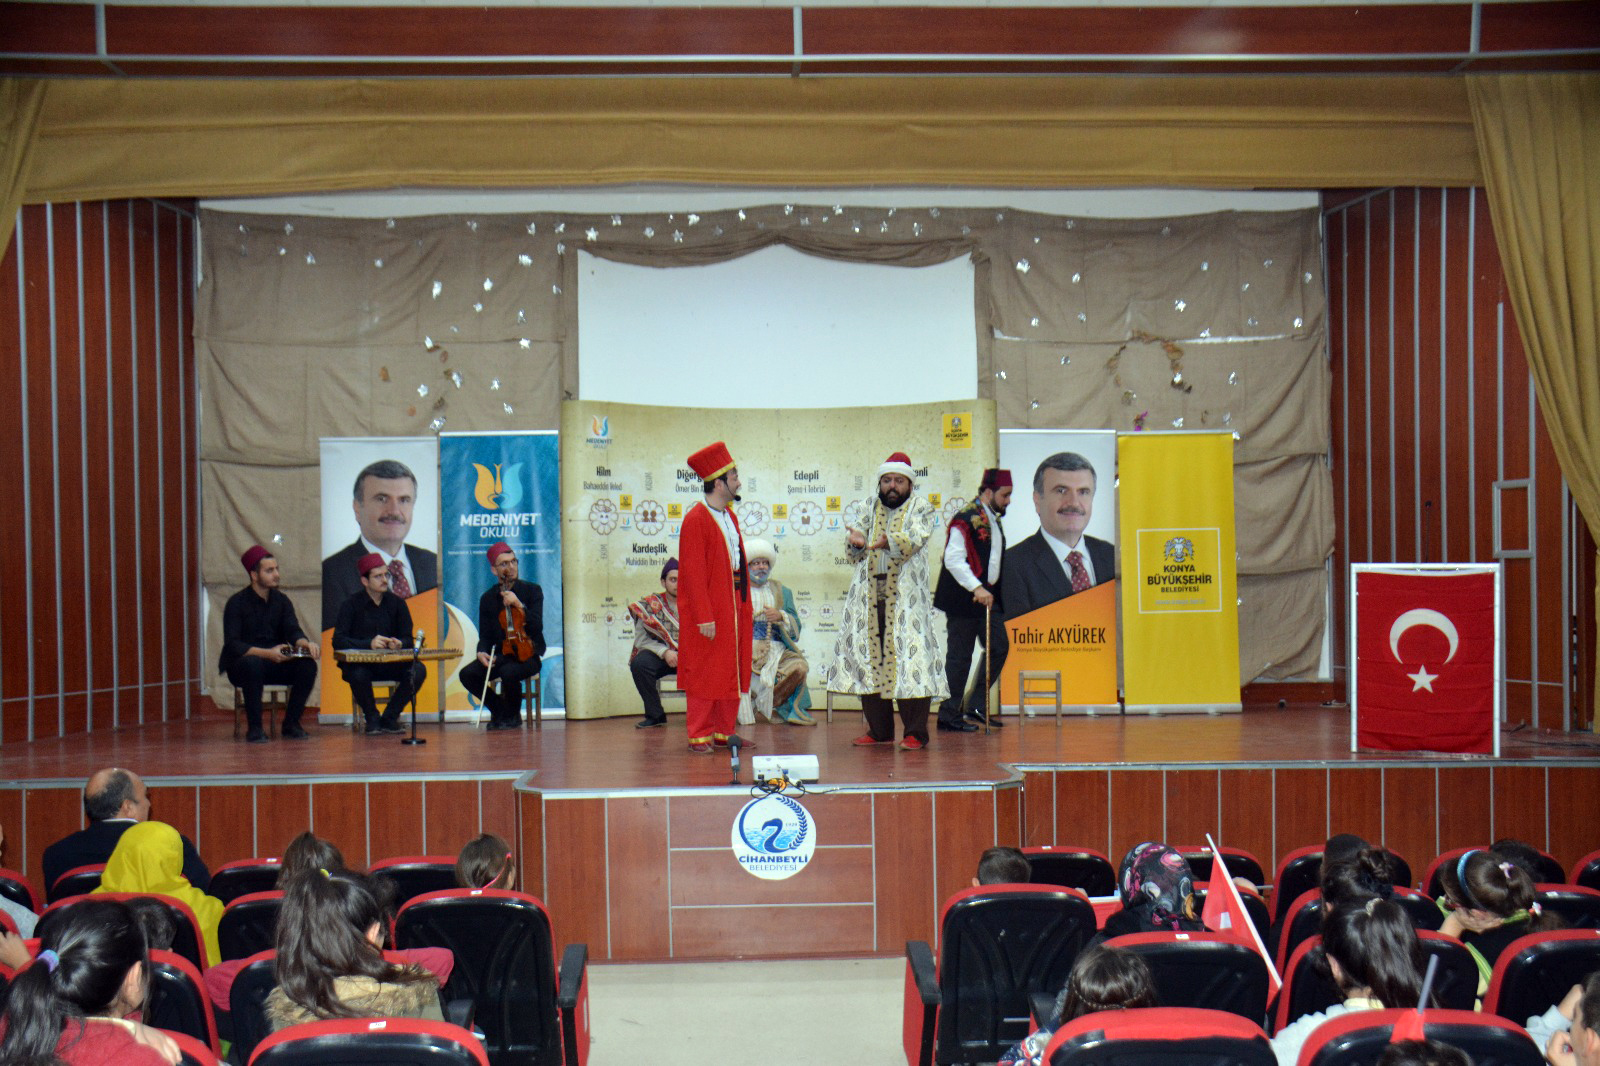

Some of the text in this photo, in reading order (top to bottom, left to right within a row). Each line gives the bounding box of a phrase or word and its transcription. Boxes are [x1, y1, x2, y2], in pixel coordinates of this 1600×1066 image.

[794, 470, 819, 482] Edepli
[914, 467, 928, 477] enli
[675, 483, 690, 493] Ömer
[691, 485, 700, 493] Bin
[748, 477, 757, 492] OCAK
[460, 513, 541, 527] MEDENİYET
[480, 527, 520, 538] OKULU
[632, 543, 668, 555] Kardeşlik
[834, 557, 848, 565] Sulta
[1163, 565, 1196, 573] KONYA
[1147, 573, 1212, 585] BÜYÜKŞEHİR
[1161, 585, 1200, 593] BELEDİYESİ
[582, 613, 597, 624] 2015
[1012, 624, 1106, 644] Tahir AKYÜREK
[738, 854, 808, 863] CİHANBEYLİ
